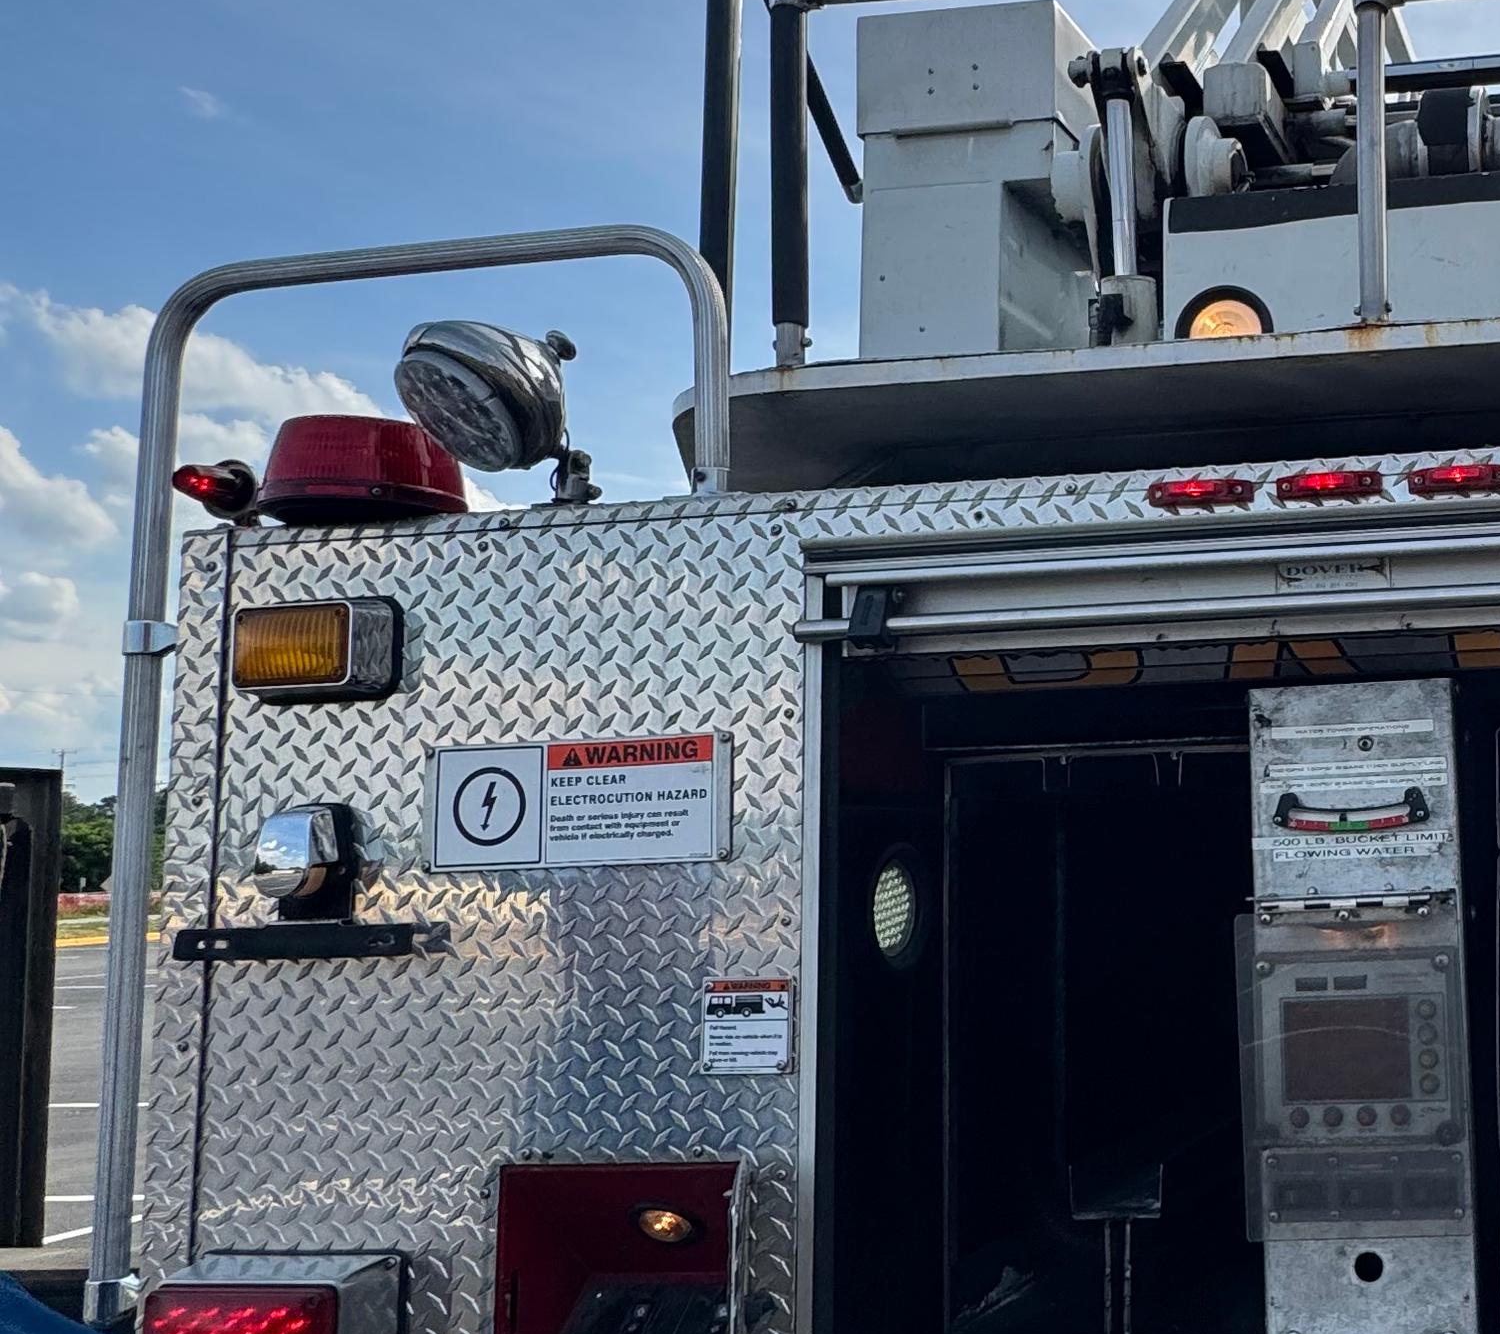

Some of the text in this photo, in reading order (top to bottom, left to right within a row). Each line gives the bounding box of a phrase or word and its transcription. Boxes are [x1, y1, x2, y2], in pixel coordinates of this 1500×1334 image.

[584, 740, 698, 764] WARNING
[551, 775, 626, 787] KEEP CLEAR
[550, 789, 707, 806] ELECTROCUTION HAZARD
[550, 814, 574, 822] Death
[588, 813, 618, 821] serious
[621, 812, 644, 821] injury
[665, 809, 689, 817] result
[550, 824, 570, 832] from
[572, 823, 602, 831] contact
[624, 820, 669, 830] equipment
[549, 833, 579, 841] vehicle
[589, 831, 634, 840] electrically
[1272, 838, 1300, 846] 500
[1335, 832, 1400, 846] BUCKET
[1275, 846, 1414, 859] FLOWING WATER
